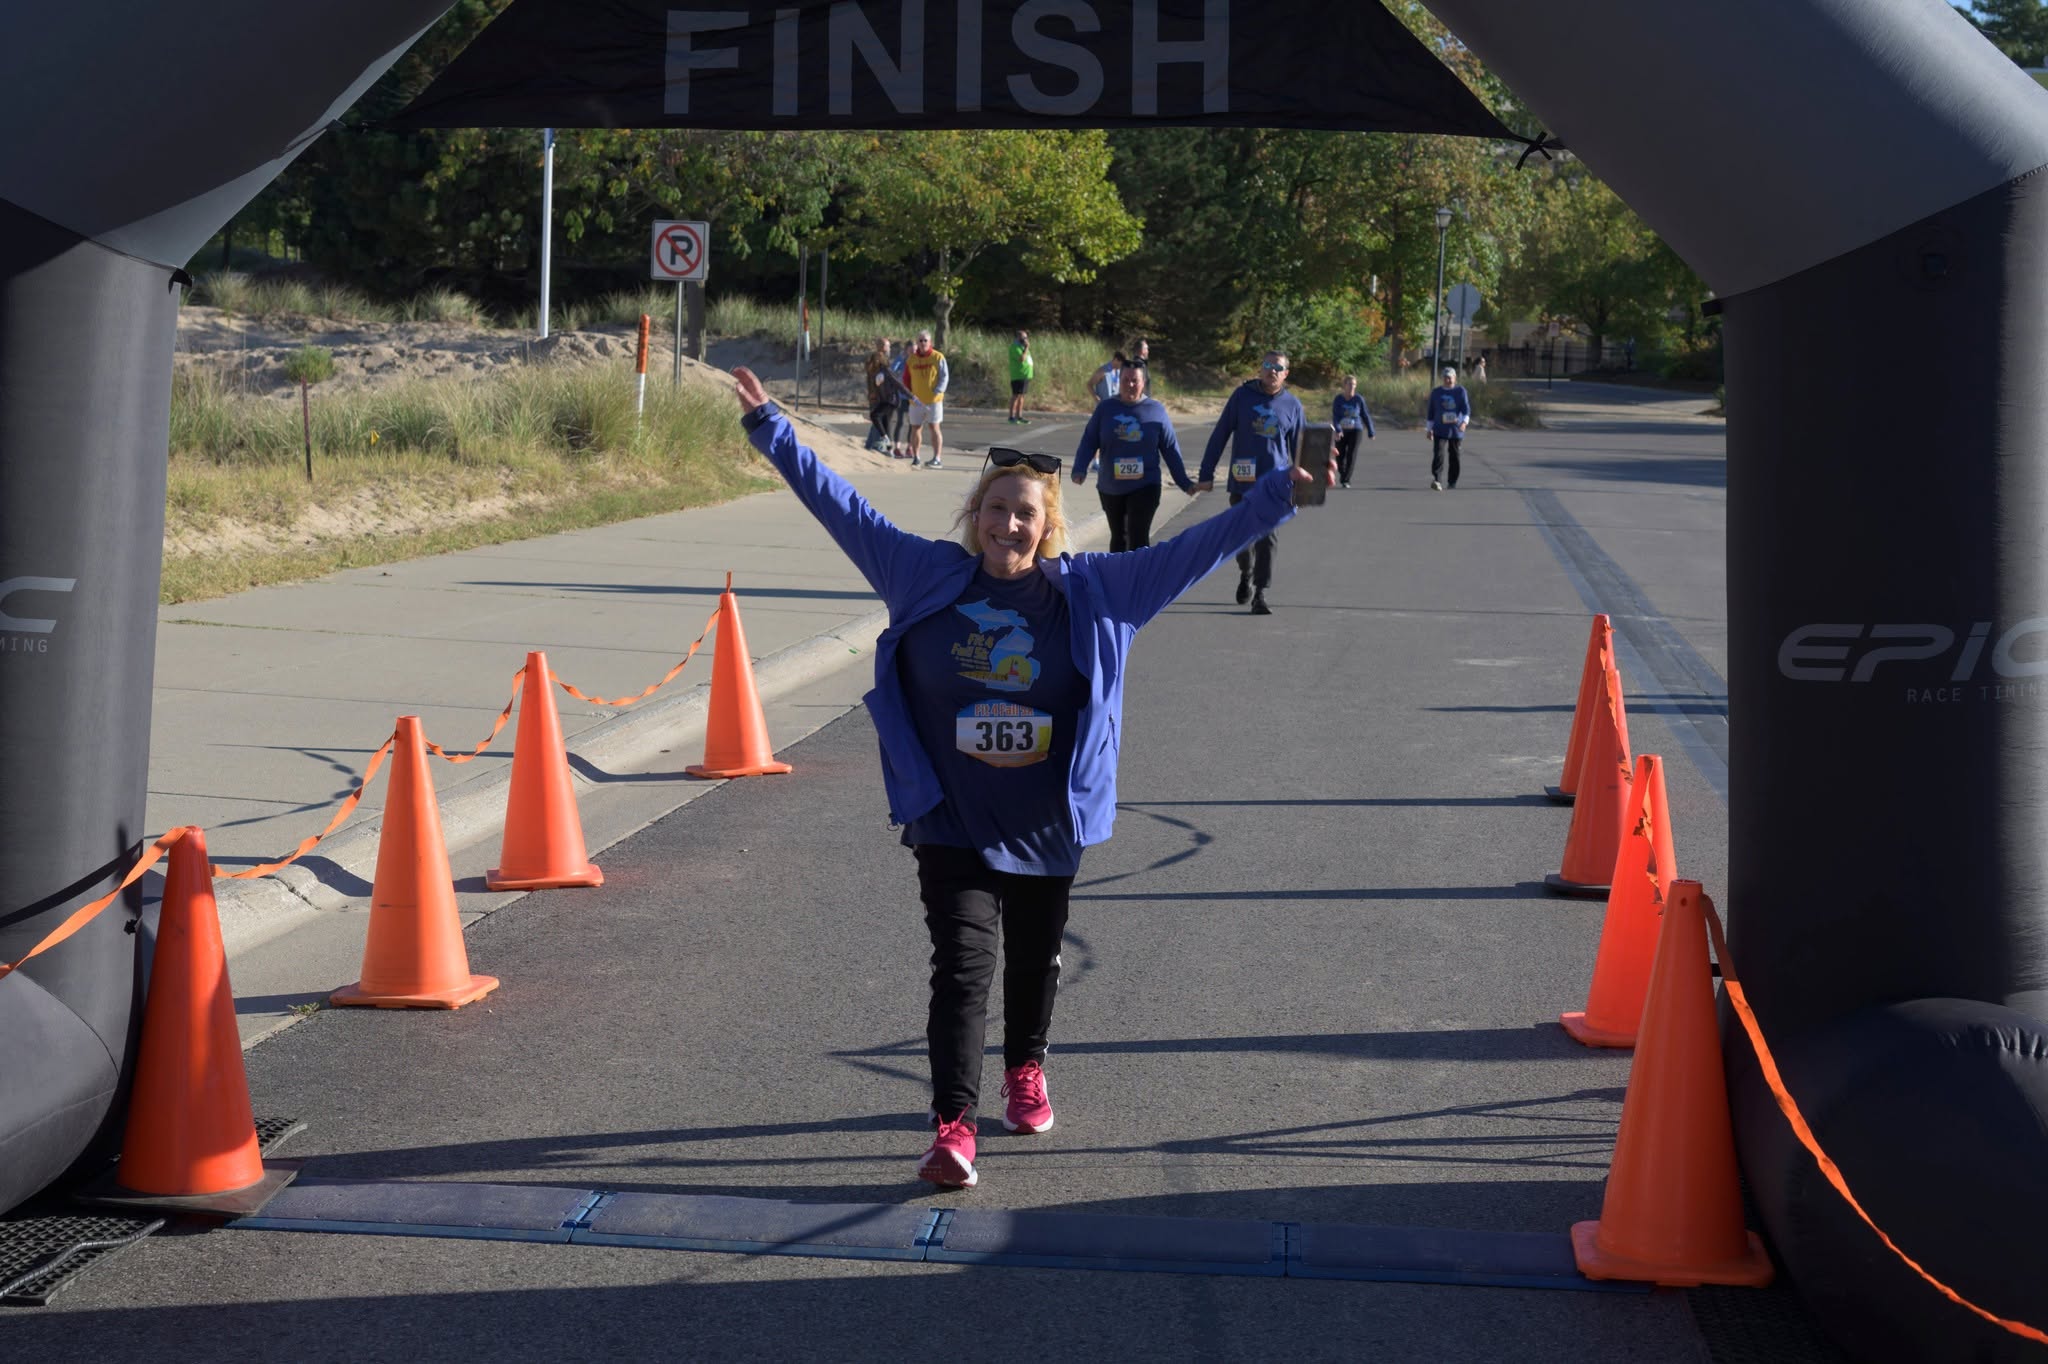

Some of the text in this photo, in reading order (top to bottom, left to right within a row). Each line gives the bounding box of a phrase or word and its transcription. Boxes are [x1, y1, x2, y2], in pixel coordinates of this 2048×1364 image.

[664, 0, 1229, 116] FINISH
[670, 235, 693, 265] P
[1120, 463, 1138, 474] 292
[1906, 687, 1961, 704] RACE
[975, 721, 1034, 751] 363
